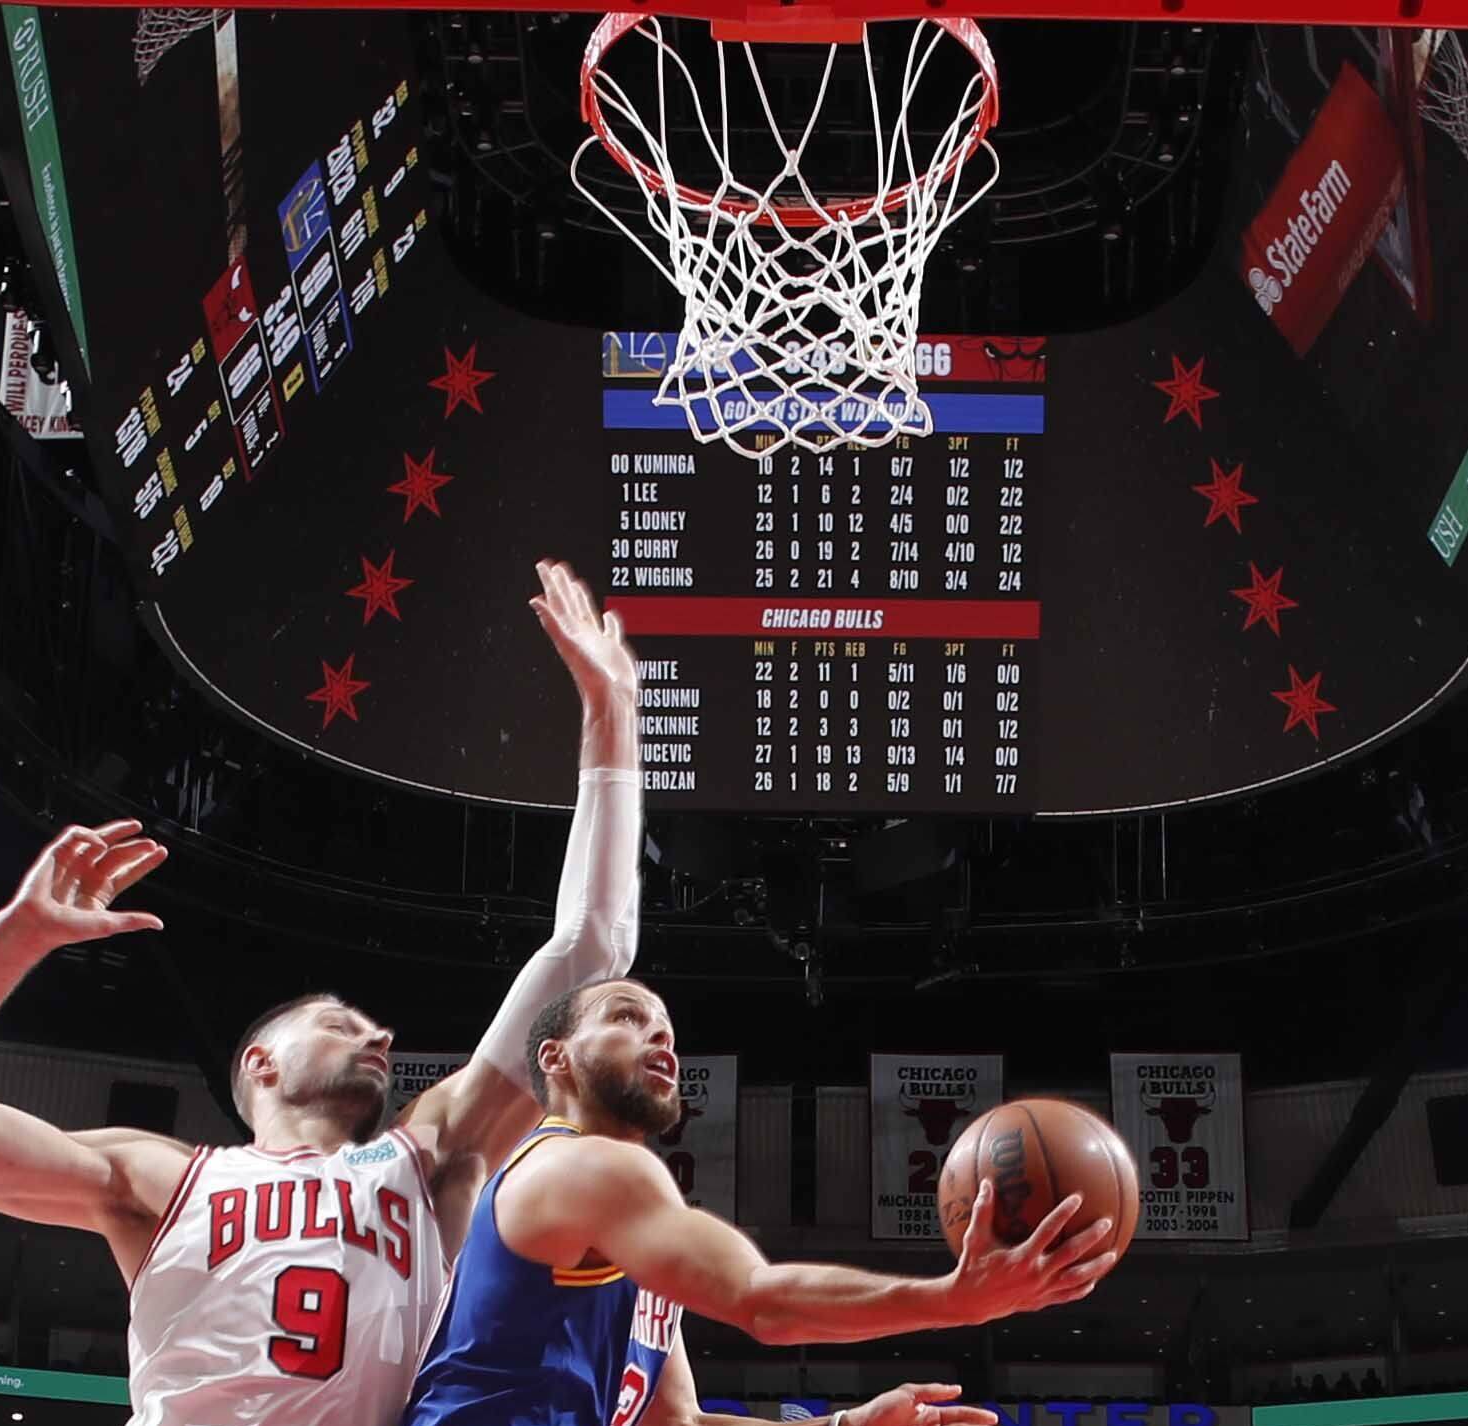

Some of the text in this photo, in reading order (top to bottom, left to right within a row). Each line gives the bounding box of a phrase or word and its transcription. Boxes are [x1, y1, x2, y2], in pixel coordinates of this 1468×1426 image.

[916, 344, 951, 376] 66
[612, 455, 695, 475] 00 KUMINGA
[623, 484, 657, 502] 1 LEE
[621, 512, 1022, 535] 5 LOONEY 23 1 10 12 4/5 0/0 2/2
[612, 539, 1021, 563] 30 CURRY 26 0 19 2 7/14 4/10 1/2
[612, 567, 693, 587] 22 WIGGINS
[762, 608, 883, 629] CHICAGO BULLS
[755, 641, 1016, 658] MIN F PTS REB FG 3PT FT
[635, 661, 678, 680] WHITE
[898, 1068, 977, 1081] CHICAGO
[1137, 1066, 1215, 1079] CHICAGO
[909, 1084, 966, 1096] BULLS
[1150, 1083, 1206, 1095] BULLS
[1150, 1146, 1210, 1189] 33
[877, 1195, 936, 1207] MICHAEL
[1188, 1191, 1234, 1204] PIPPEN
[207, 1178, 411, 1280] BULLS
[268, 1266, 349, 1381] 9
